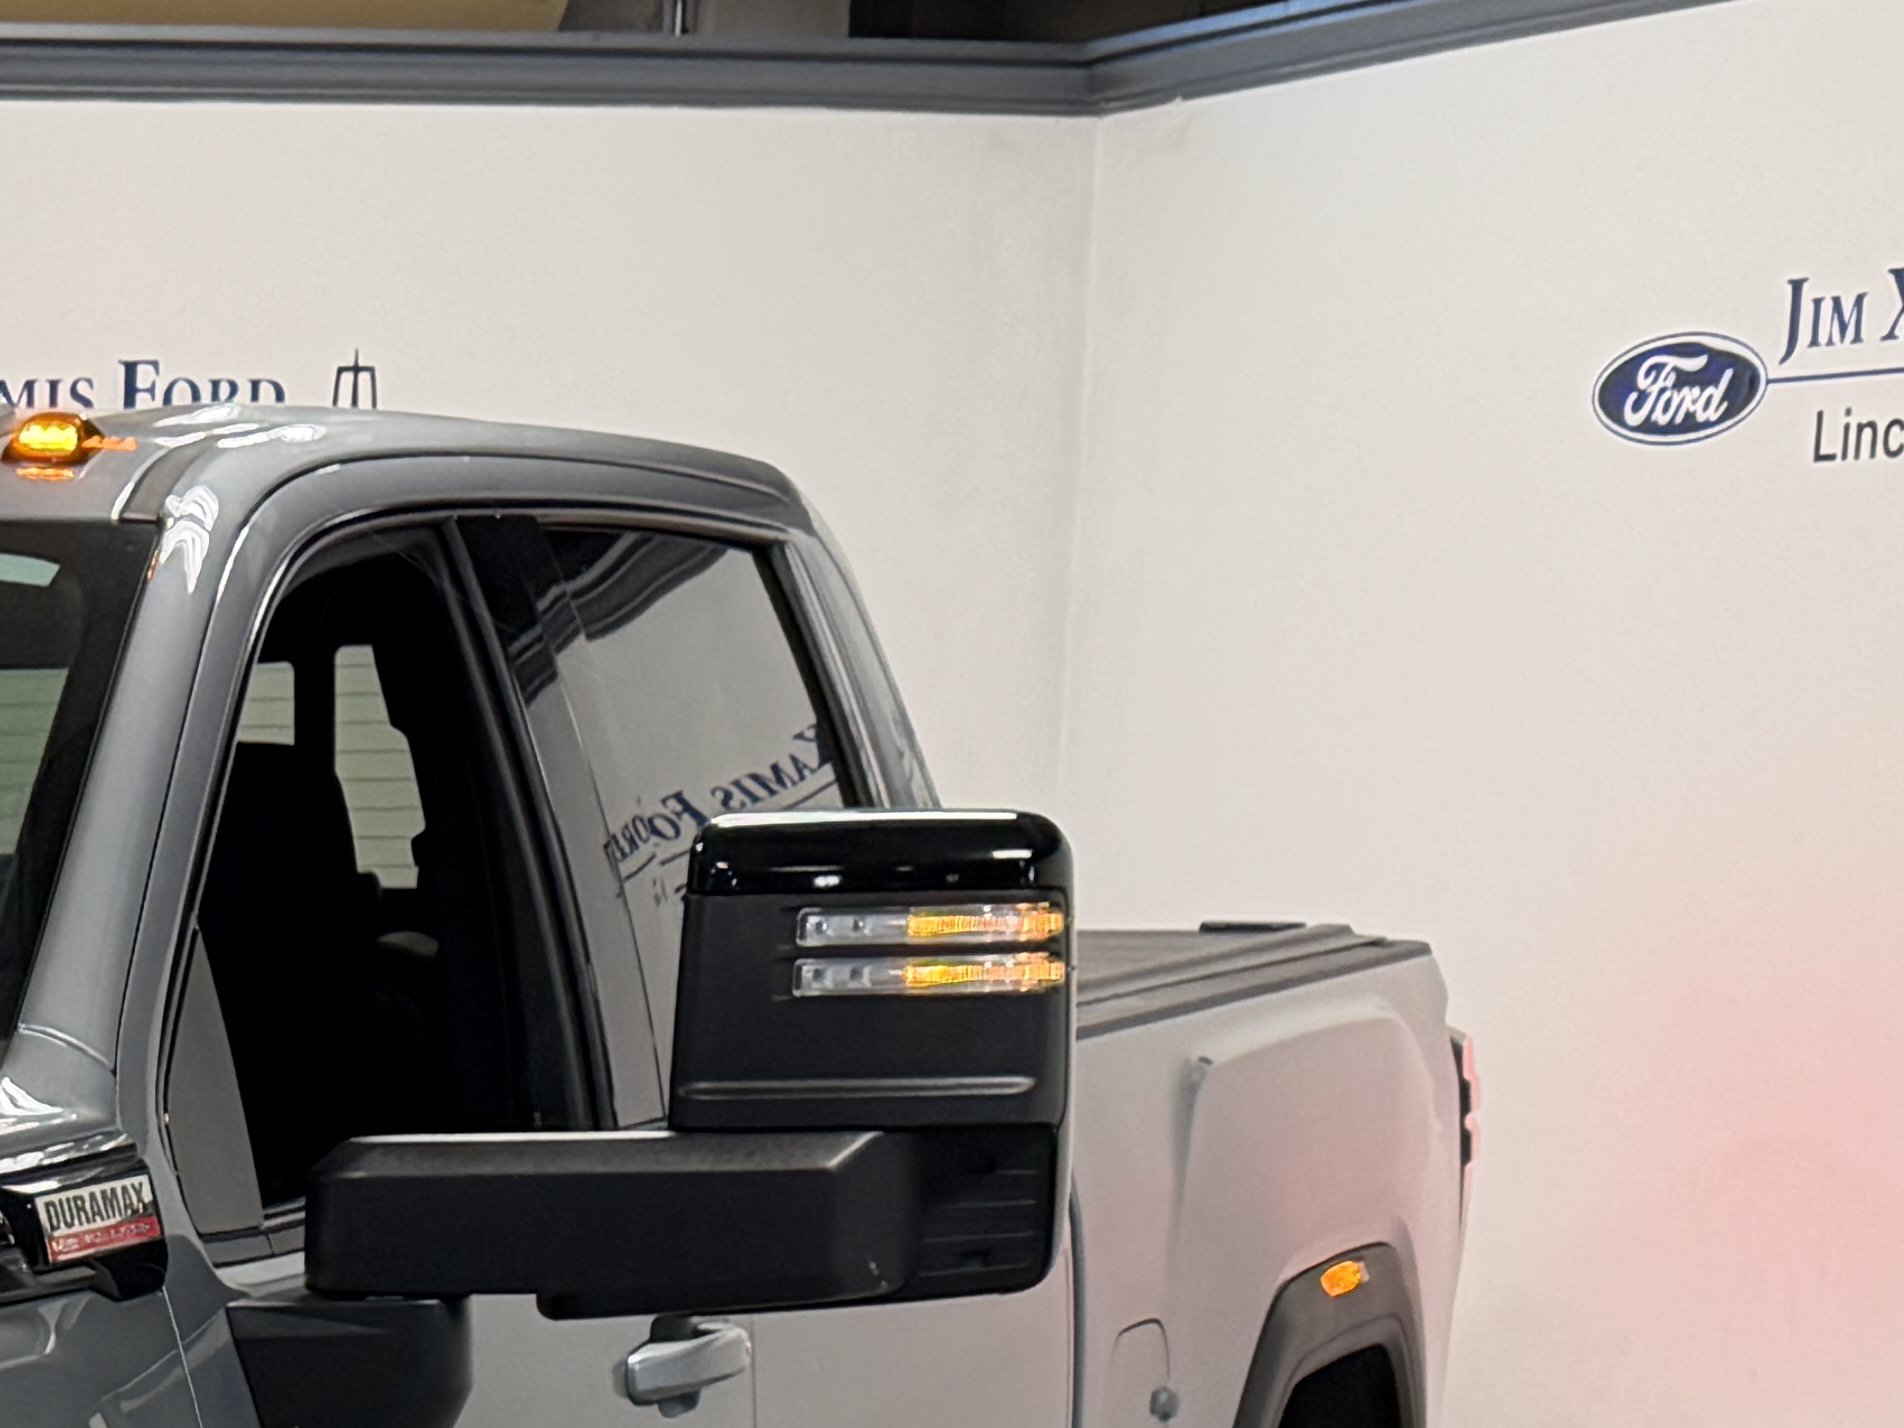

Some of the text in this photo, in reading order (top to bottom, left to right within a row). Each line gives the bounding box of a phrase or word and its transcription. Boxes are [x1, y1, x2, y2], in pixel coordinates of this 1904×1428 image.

[1779, 277, 1869, 365] JIM
[1624, 353, 1734, 427] Ford
[44, 1182, 145, 1233] DURAMAX
